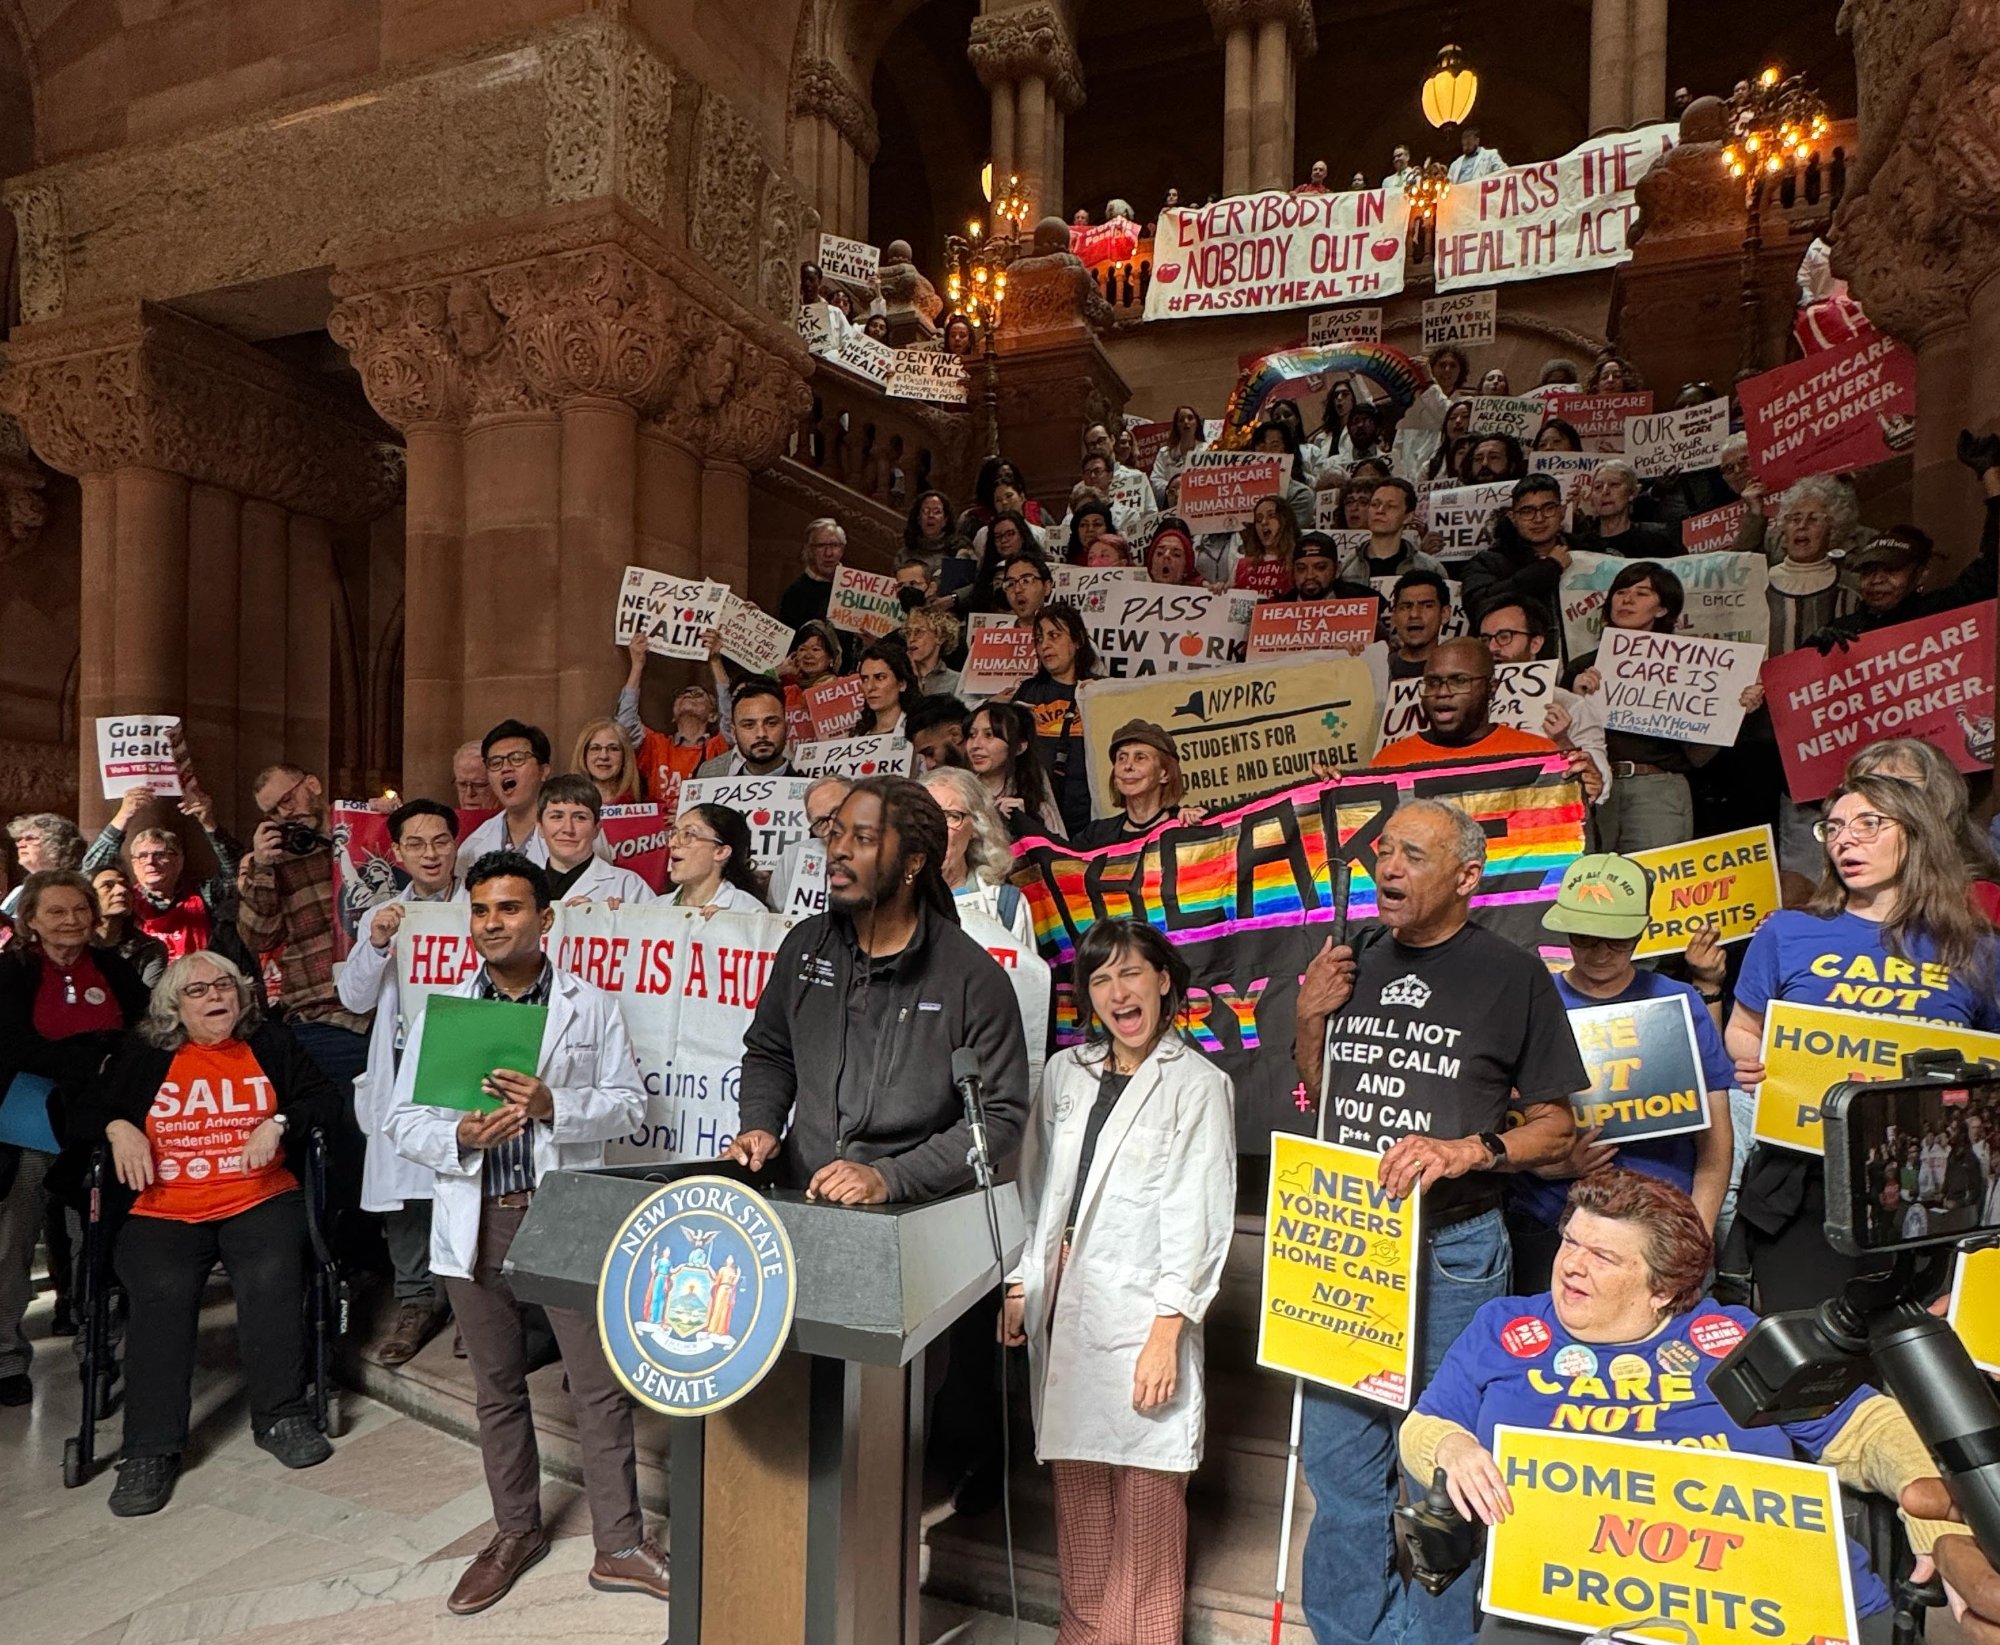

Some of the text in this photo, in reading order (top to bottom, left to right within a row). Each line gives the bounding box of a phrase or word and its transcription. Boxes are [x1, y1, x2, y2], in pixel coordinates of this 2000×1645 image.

[1480, 139, 1643, 221] PASS THE
[1178, 195, 1339, 247] EVERYBODY
[1356, 190, 1385, 228] IN
[822, 249, 846, 261] NEW
[836, 241, 865, 254] PASS
[1438, 204, 1639, 280] HEALTH ACT
[821, 258, 876, 281] HEALTH
[1184, 233, 1370, 289] NOBODY OUT
[1168, 272, 1380, 312] #PASSNYHEALTH
[1440, 295, 1475, 314] PASS
[1327, 309, 1362, 327] PASS
[1425, 315, 1452, 328] NEW
[1311, 328, 1339, 341] NEW
[1425, 323, 1492, 344] HEALTH
[846, 343, 871, 357] NEW
[863, 341, 891, 358] PASS
[895, 363, 928, 376] CARE
[1759, 335, 1896, 424] HEALTHCARE
[1564, 396, 1647, 412] HEALTHCARE
[1773, 363, 1884, 438] FOR EVERY
[1495, 412, 1526, 425] LESS
[1592, 409, 1617, 421] IS A
[1761, 431, 1806, 466] NEW
[1810, 380, 1904, 438] YORKER.
[1632, 416, 1675, 446] OUR
[1669, 437, 1703, 453] YOUR
[1681, 443, 1720, 461] CHOICE
[1188, 467, 1273, 488] HEALTHCARE
[1217, 484, 1243, 495] IS A
[1185, 499, 1234, 513] HUMAN
[1475, 486, 1513, 504] PAS
[1435, 508, 1488, 527] NEW
[1725, 517, 1740, 531] IS
[649, 581, 704, 602] PASS
[840, 570, 880, 592] SAVE
[1248, 575, 1278, 586] OVER
[622, 594, 667, 615] NEW
[1120, 595, 1212, 625] PASS
[1262, 603, 1369, 620] HEALTHCARE
[1703, 594, 1746, 607] BMCC
[718, 623, 753, 648] PEOPLE
[1296, 618, 1328, 631] IS A
[1013, 645, 1028, 657] IS
[1252, 629, 1371, 647] HUMAN RIGHT
[972, 658, 1031, 670] HUMAN
[1613, 634, 1735, 671] DENYING
[1788, 617, 1980, 711] HEALTHCARE
[1616, 660, 1720, 693] CARE IS
[814, 679, 862, 704] HEALT
[851, 693, 865, 707] IS
[1207, 681, 1276, 715] NYPIRG
[1604, 681, 1720, 717] VIOLENCE
[1811, 652, 1964, 729] FOR EVERY
[818, 710, 862, 733] HUMA
[1796, 675, 1994, 763] NEW YORKER.
[110, 741, 171, 758] Healt
[824, 738, 881, 764] PASS
[1180, 724, 1297, 762] STUDENTS FOR
[658, 764, 682, 789] SA
[1182, 743, 1359, 793] DABLE AND EQUITABLE
[342, 800, 368, 811] FOR
[712, 780, 777, 805] PASS
[600, 804, 652, 817] FOR ALL!
[608, 830, 668, 860] YORK
[1702, 842, 1770, 873] CARE
[1668, 875, 1736, 911] NOT
[1648, 902, 1757, 940] PROFITS
[558, 935, 708, 999] CARE IS A
[1810, 953, 1950, 992] CARE
[1824, 982, 1932, 1011] NOT
[1335, 1016, 1462, 1048] I WILL NOT
[1773, 1024, 1899, 1067] HOME
[1329, 1041, 1461, 1080] KEEP CALM
[150, 1076, 270, 1118] SALT
[1355, 1072, 1406, 1098] AND
[155, 1119, 202, 1134] Senior
[1334, 1096, 1432, 1132] YOU CAN
[157, 1132, 233, 1149] Leadership
[1312, 1167, 1404, 1214] NEW
[1278, 1190, 1403, 1238] YORKERS
[620, 1187, 783, 1280] NEW YORK STATE
[1273, 1215, 1367, 1257] NEED
[1272, 1241, 1406, 1292] HOME CARE
[1312, 1282, 1374, 1313] NOT
[1270, 1297, 1404, 1347] Corruption!
[1697, 1326, 1740, 1342] CARING
[1515, 1325, 1536, 1346] PAY
[631, 1361, 719, 1403] SENATE
[1527, 1367, 1696, 1403] CARE
[1549, 1402, 1671, 1432] NOT
[1506, 1456, 1827, 1533] HOME CARE
[1589, 1513, 1745, 1572] NOT
[1542, 1562, 1787, 1637] PROFITS
